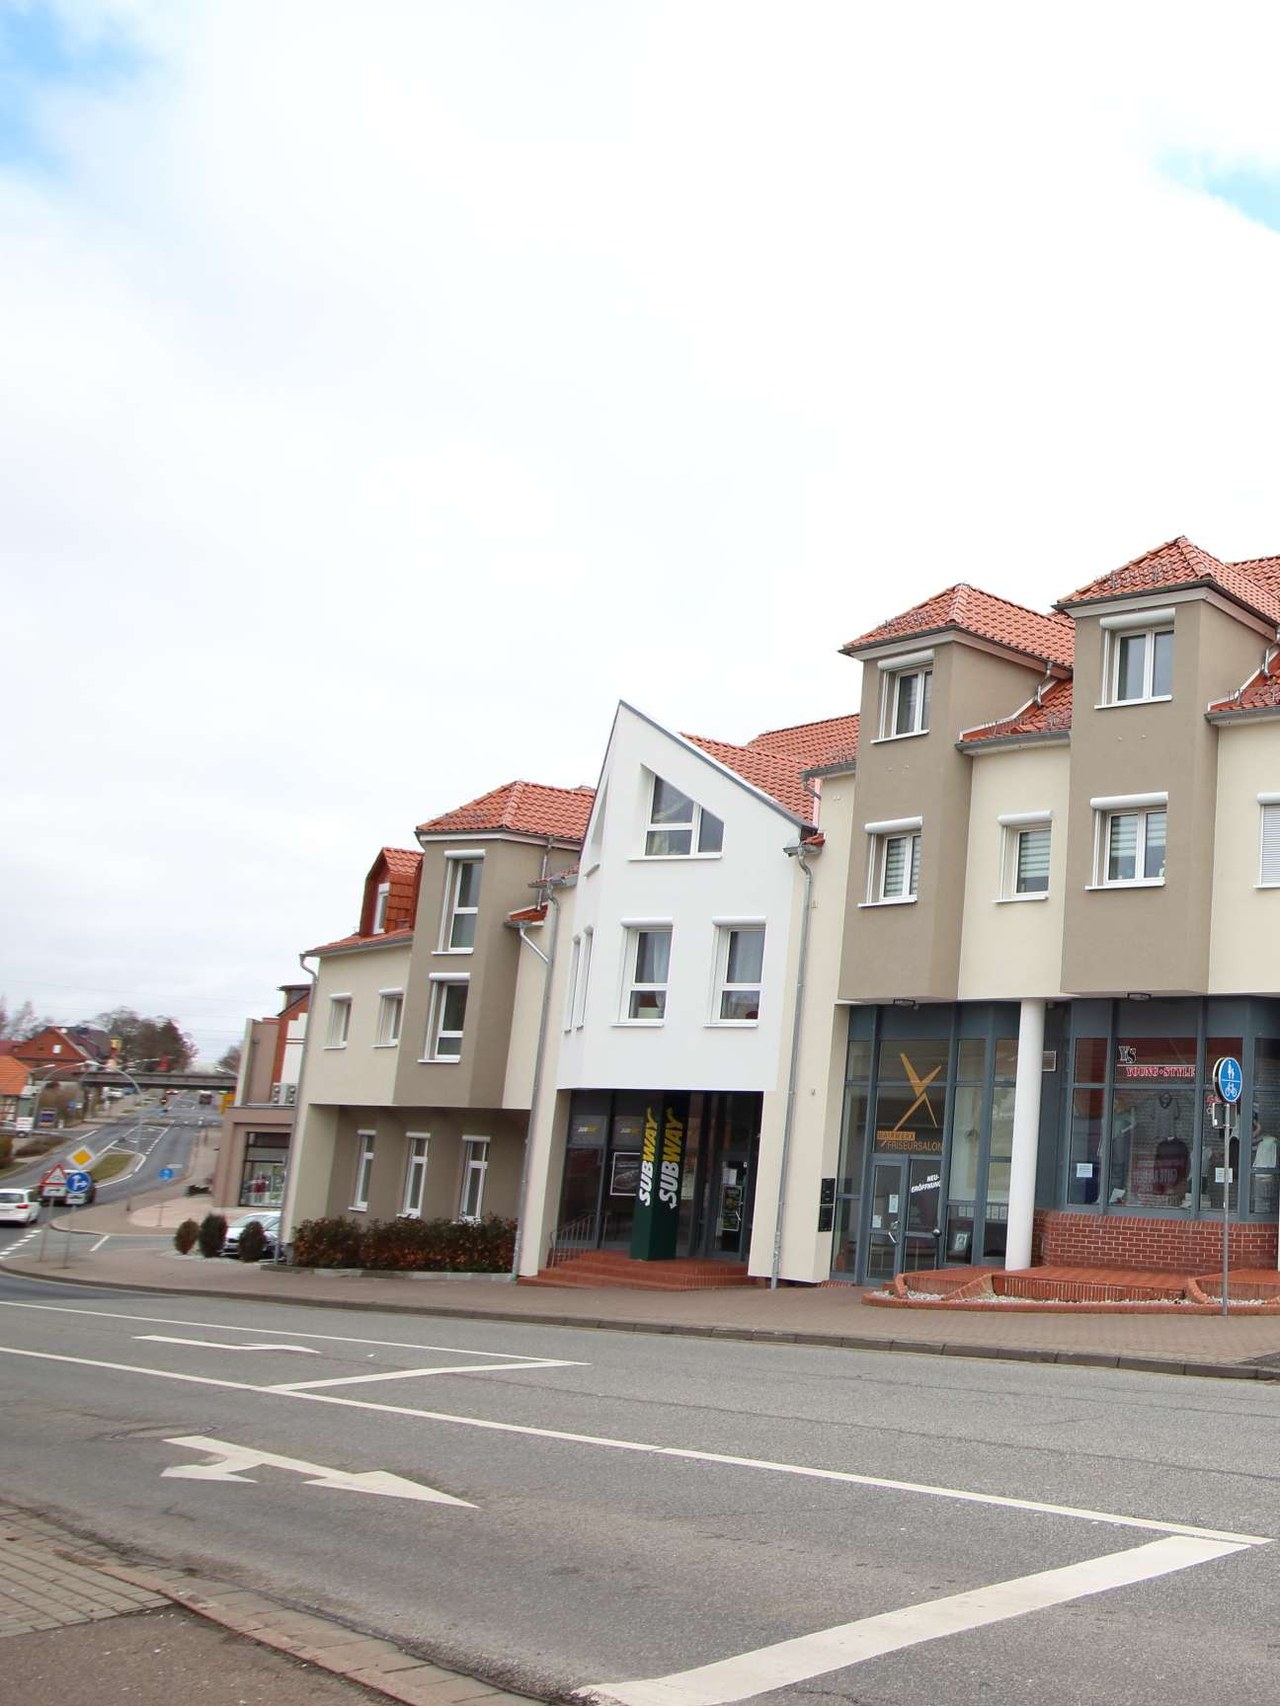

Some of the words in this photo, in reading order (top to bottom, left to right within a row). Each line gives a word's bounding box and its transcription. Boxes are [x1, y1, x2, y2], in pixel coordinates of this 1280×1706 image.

[639, 1107, 657, 1206] SUBWAY
[659, 1107, 682, 1209] SUBWAY
[887, 1140, 944, 1152] FRISEURSALON
